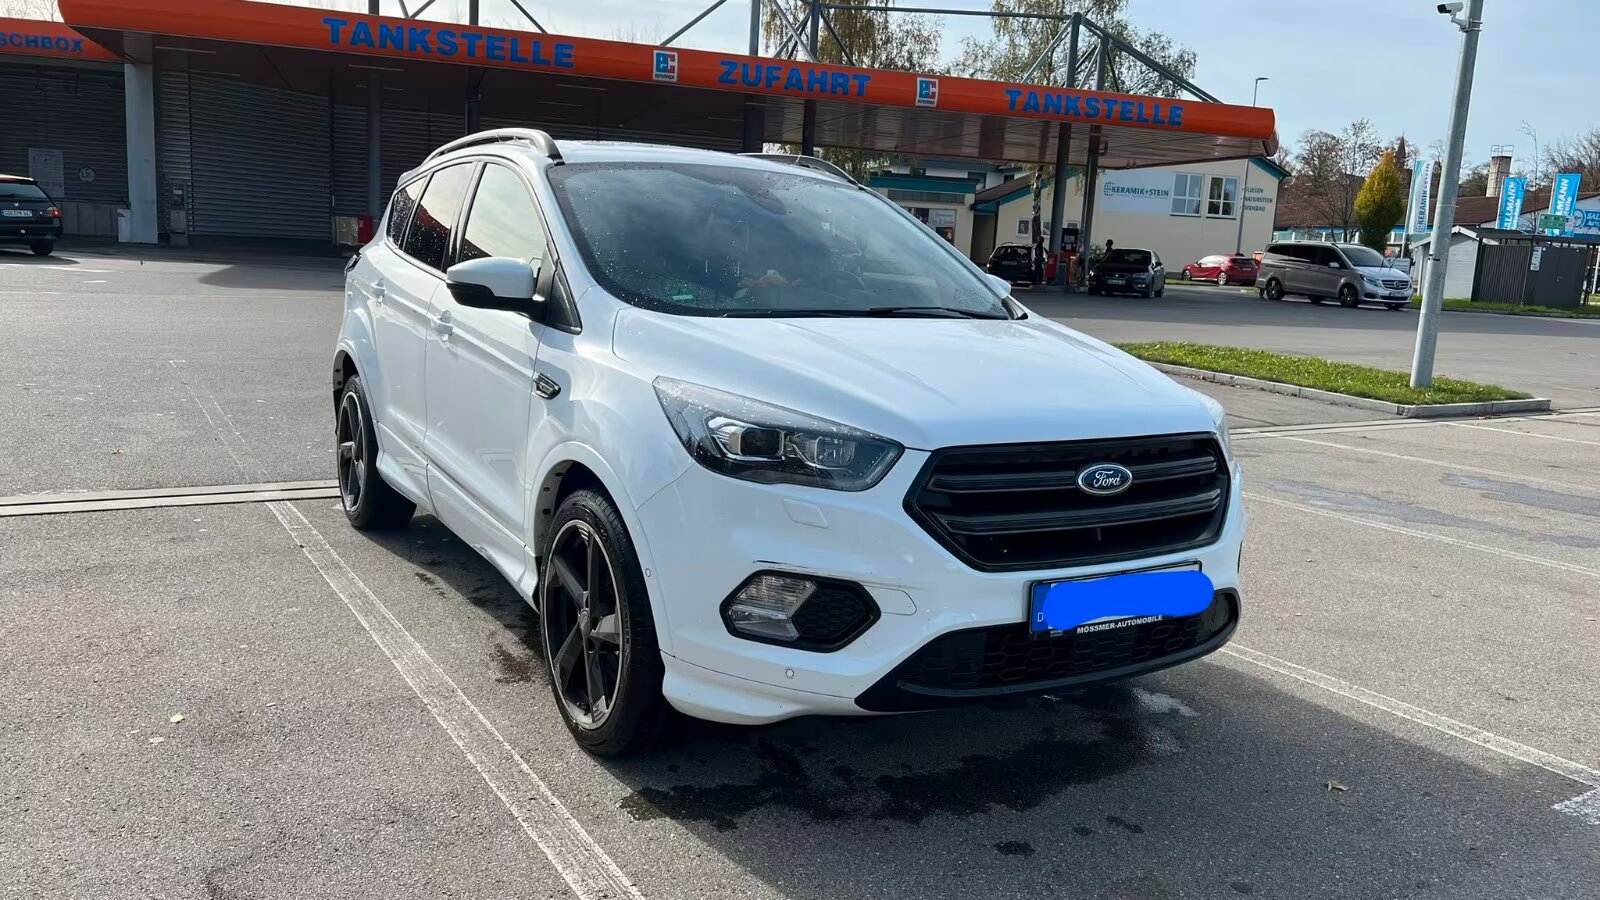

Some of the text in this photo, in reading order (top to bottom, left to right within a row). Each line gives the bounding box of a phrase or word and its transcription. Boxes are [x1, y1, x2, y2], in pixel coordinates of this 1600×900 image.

[322, 17, 576, 69] TANKSTELLE
[717, 60, 872, 97] ZUFAHRT
[1005, 89, 1184, 127] TANKSTELLE
[1111, 186, 1169, 197] KERAMIK+STEIN
[1093, 470, 1121, 488] Ford
[1037, 612, 1044, 623] D
[1076, 614, 1163, 634] MÖSSMER-AUTOMOBILE
